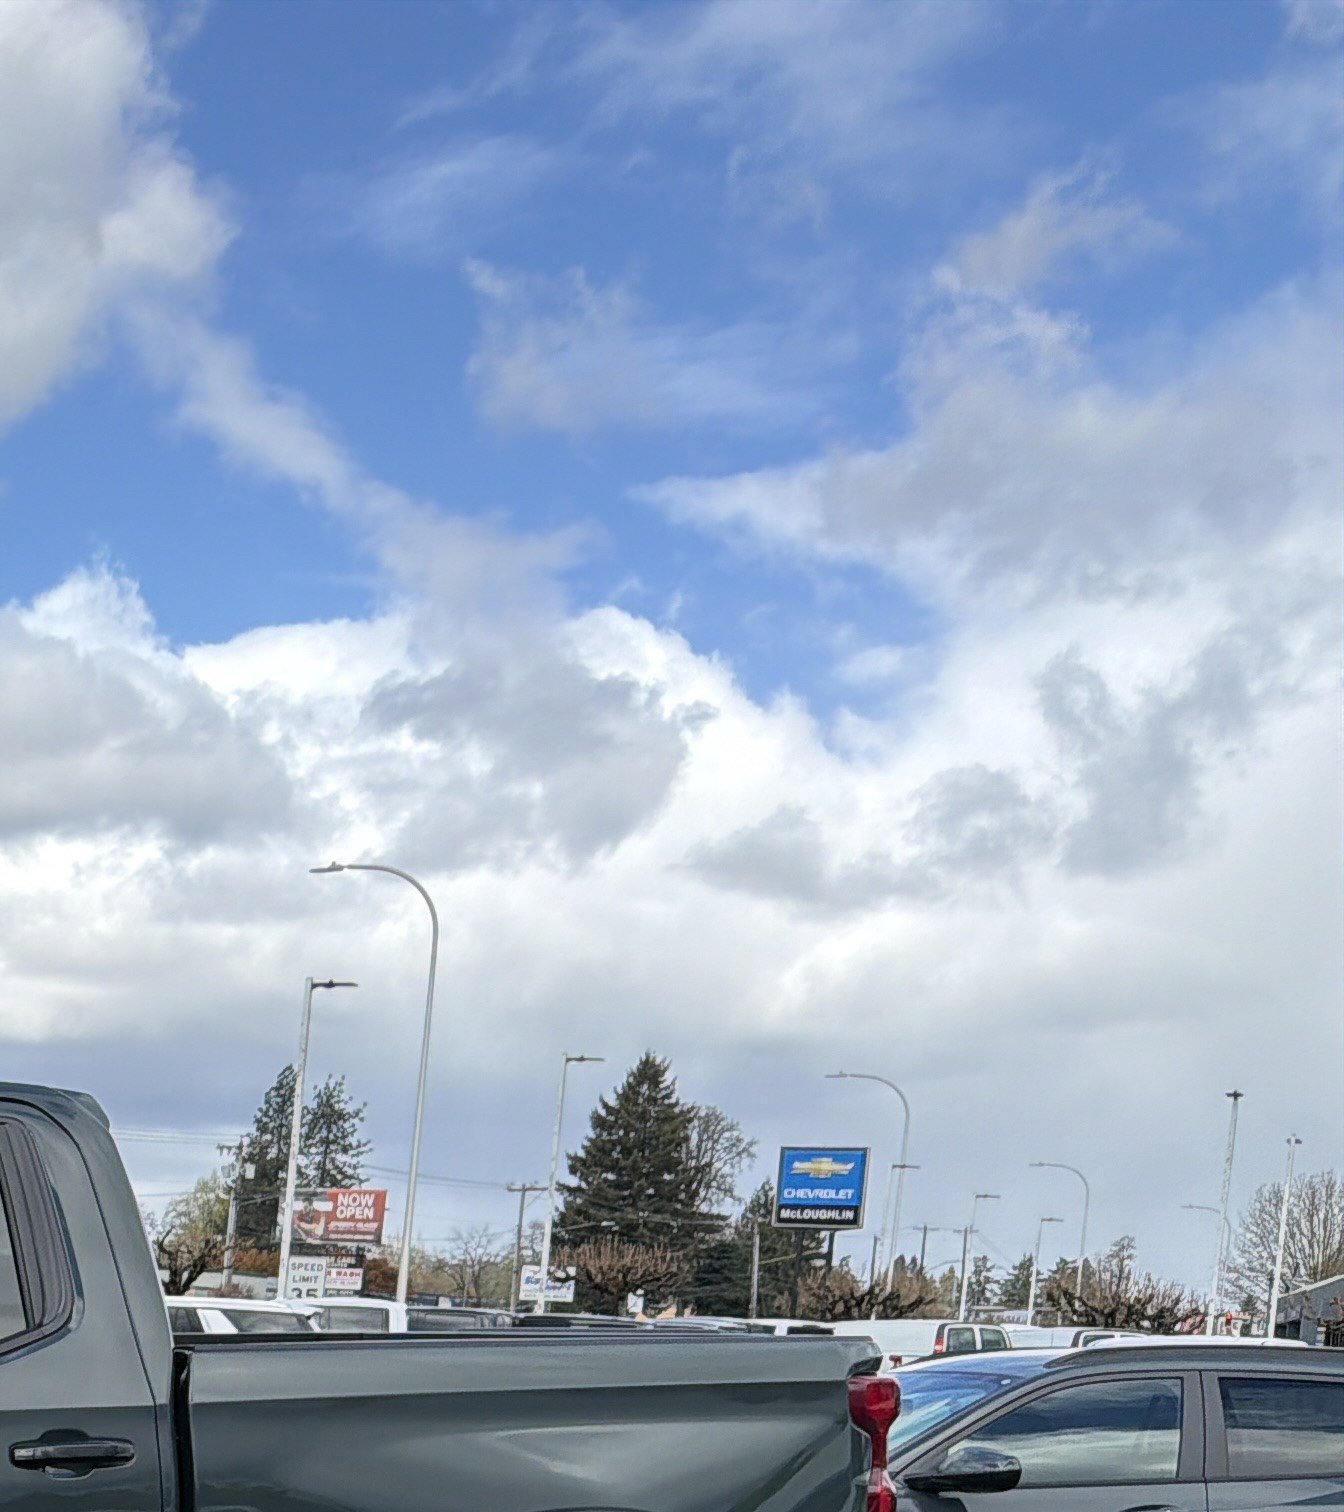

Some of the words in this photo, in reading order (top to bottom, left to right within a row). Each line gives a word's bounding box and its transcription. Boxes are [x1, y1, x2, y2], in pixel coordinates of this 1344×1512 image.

[783, 1188, 854, 1199] CHEVROLET
[336, 1193, 375, 1207] NOW
[335, 1206, 374, 1220] OPEN
[779, 1208, 854, 1220] McLOUGHLIN
[291, 1262, 323, 1272] SPEED
[292, 1275, 319, 1284] LIMIT
